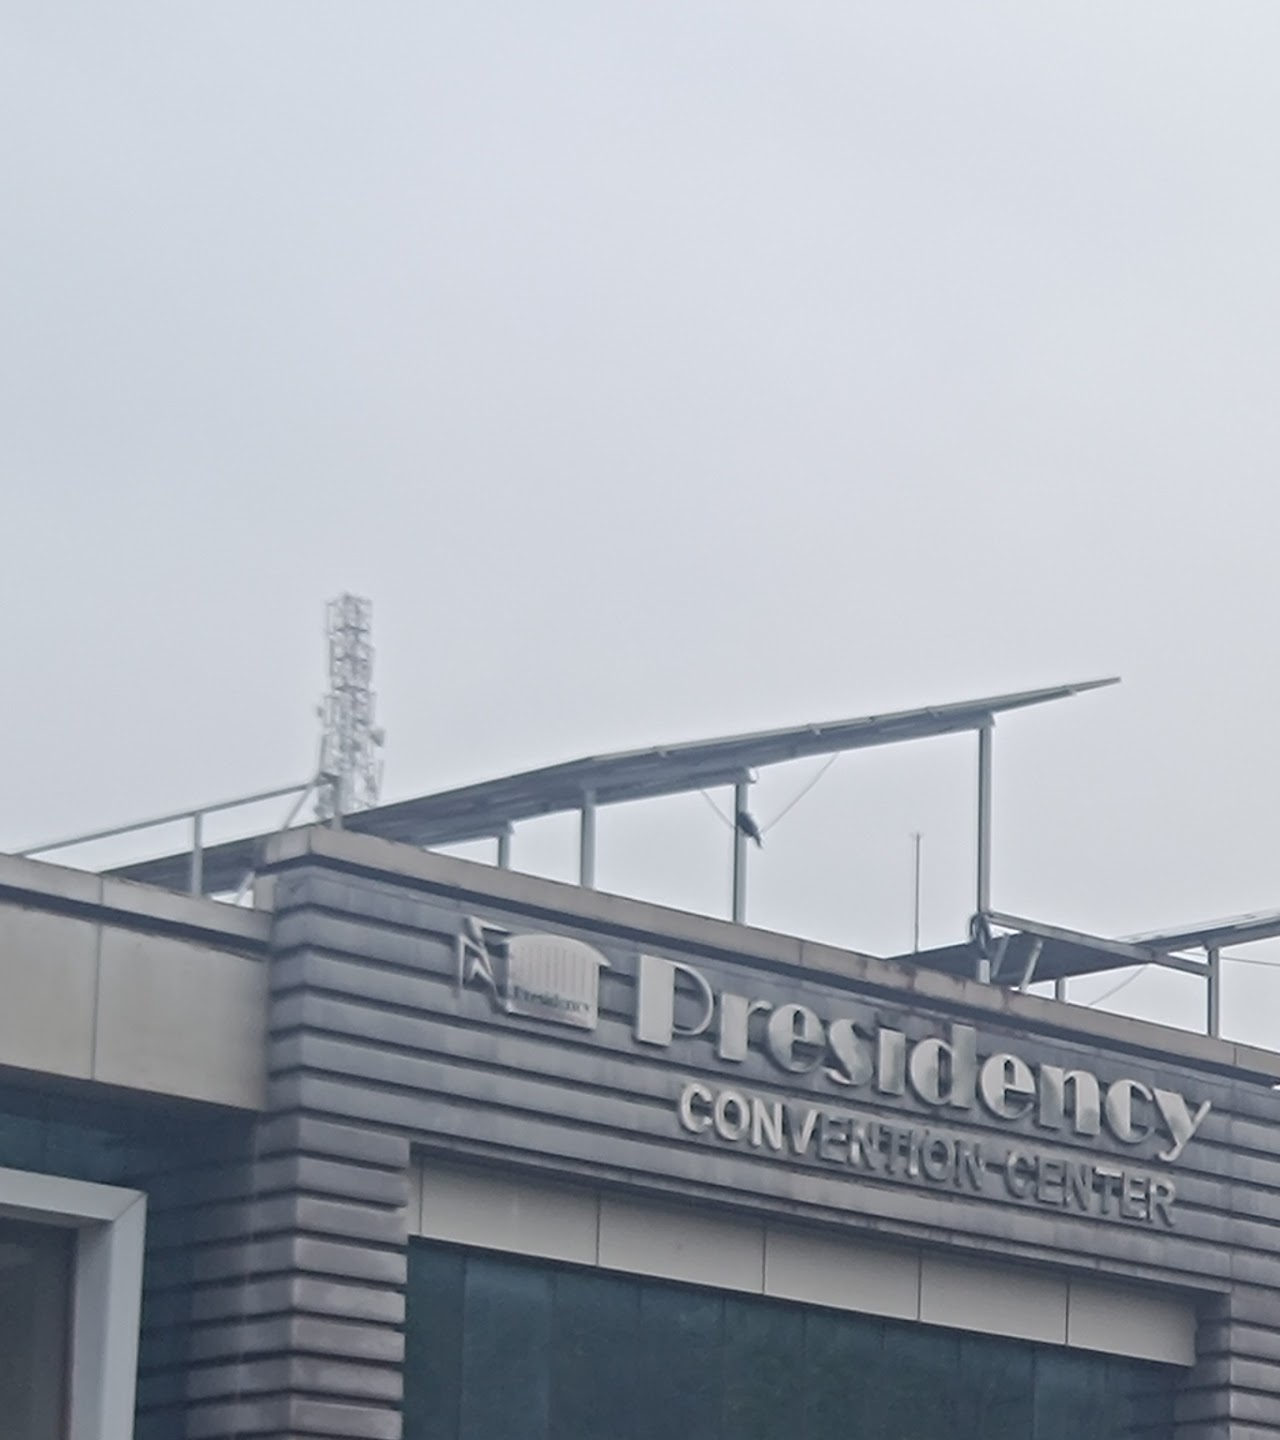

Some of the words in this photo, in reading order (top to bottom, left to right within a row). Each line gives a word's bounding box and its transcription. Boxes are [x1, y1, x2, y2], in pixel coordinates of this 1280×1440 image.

[633, 953, 1212, 1162] Presidency
[678, 1082, 986, 1192] CONVENTION
[1003, 1149, 1178, 1228] CENTER
